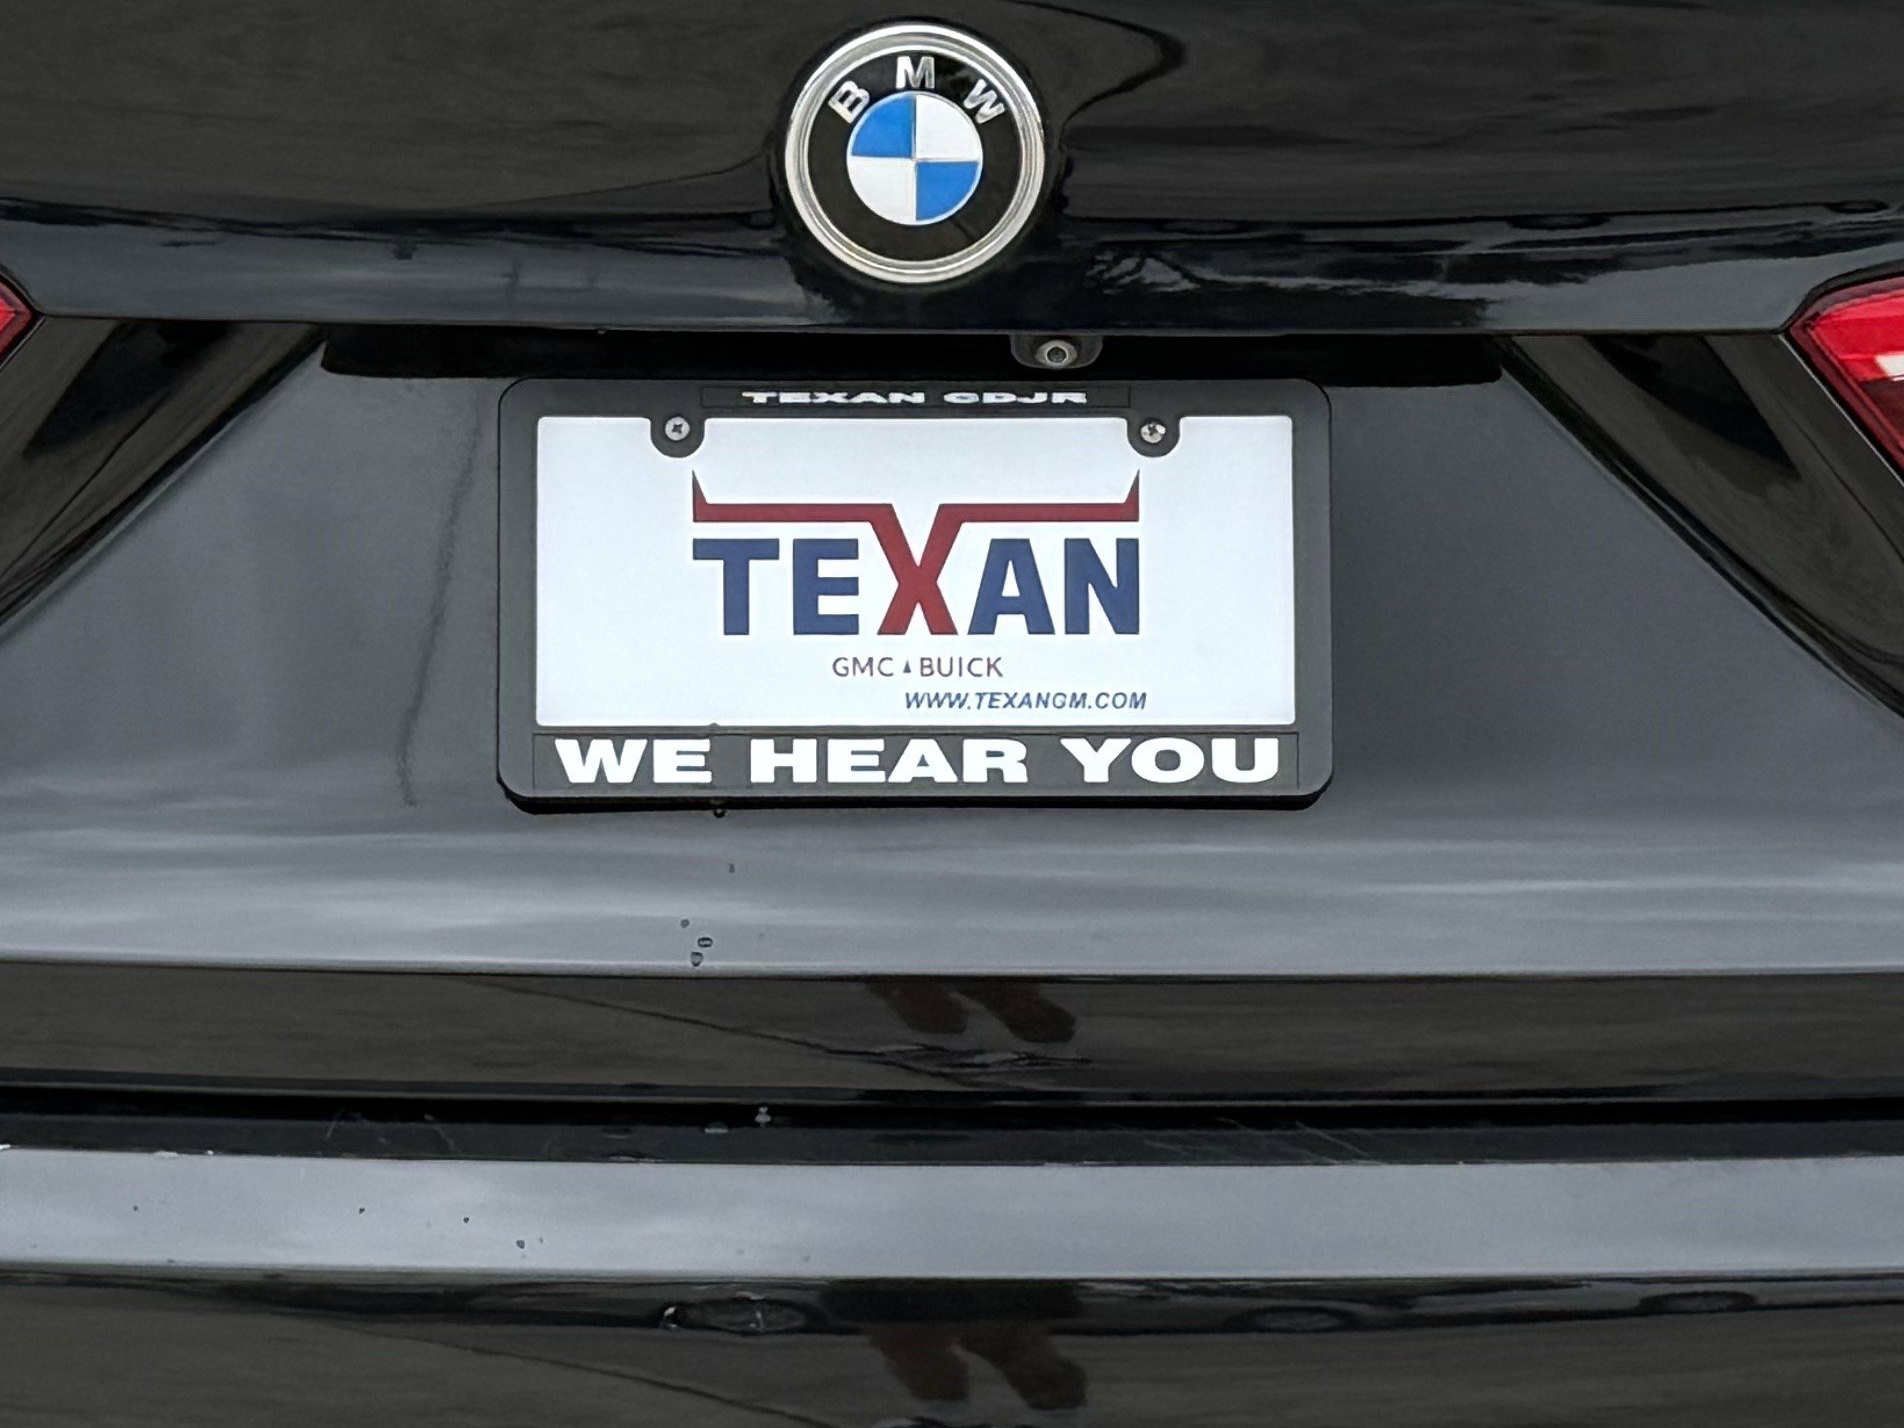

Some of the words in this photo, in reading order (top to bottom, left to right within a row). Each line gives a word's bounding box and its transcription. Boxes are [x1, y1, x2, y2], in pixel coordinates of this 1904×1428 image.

[827, 55, 1005, 124] BMW
[741, 392, 925, 404] TEXAN
[692, 502, 1140, 635] TEXAN
[832, 657, 895, 678] GMC
[919, 657, 1004, 678] BUICK
[905, 692, 1147, 710] WWW.TEXANGM.COM
[555, 738, 712, 784] WE
[750, 739, 1028, 784] HEAR
[1061, 739, 1281, 784] YOU
